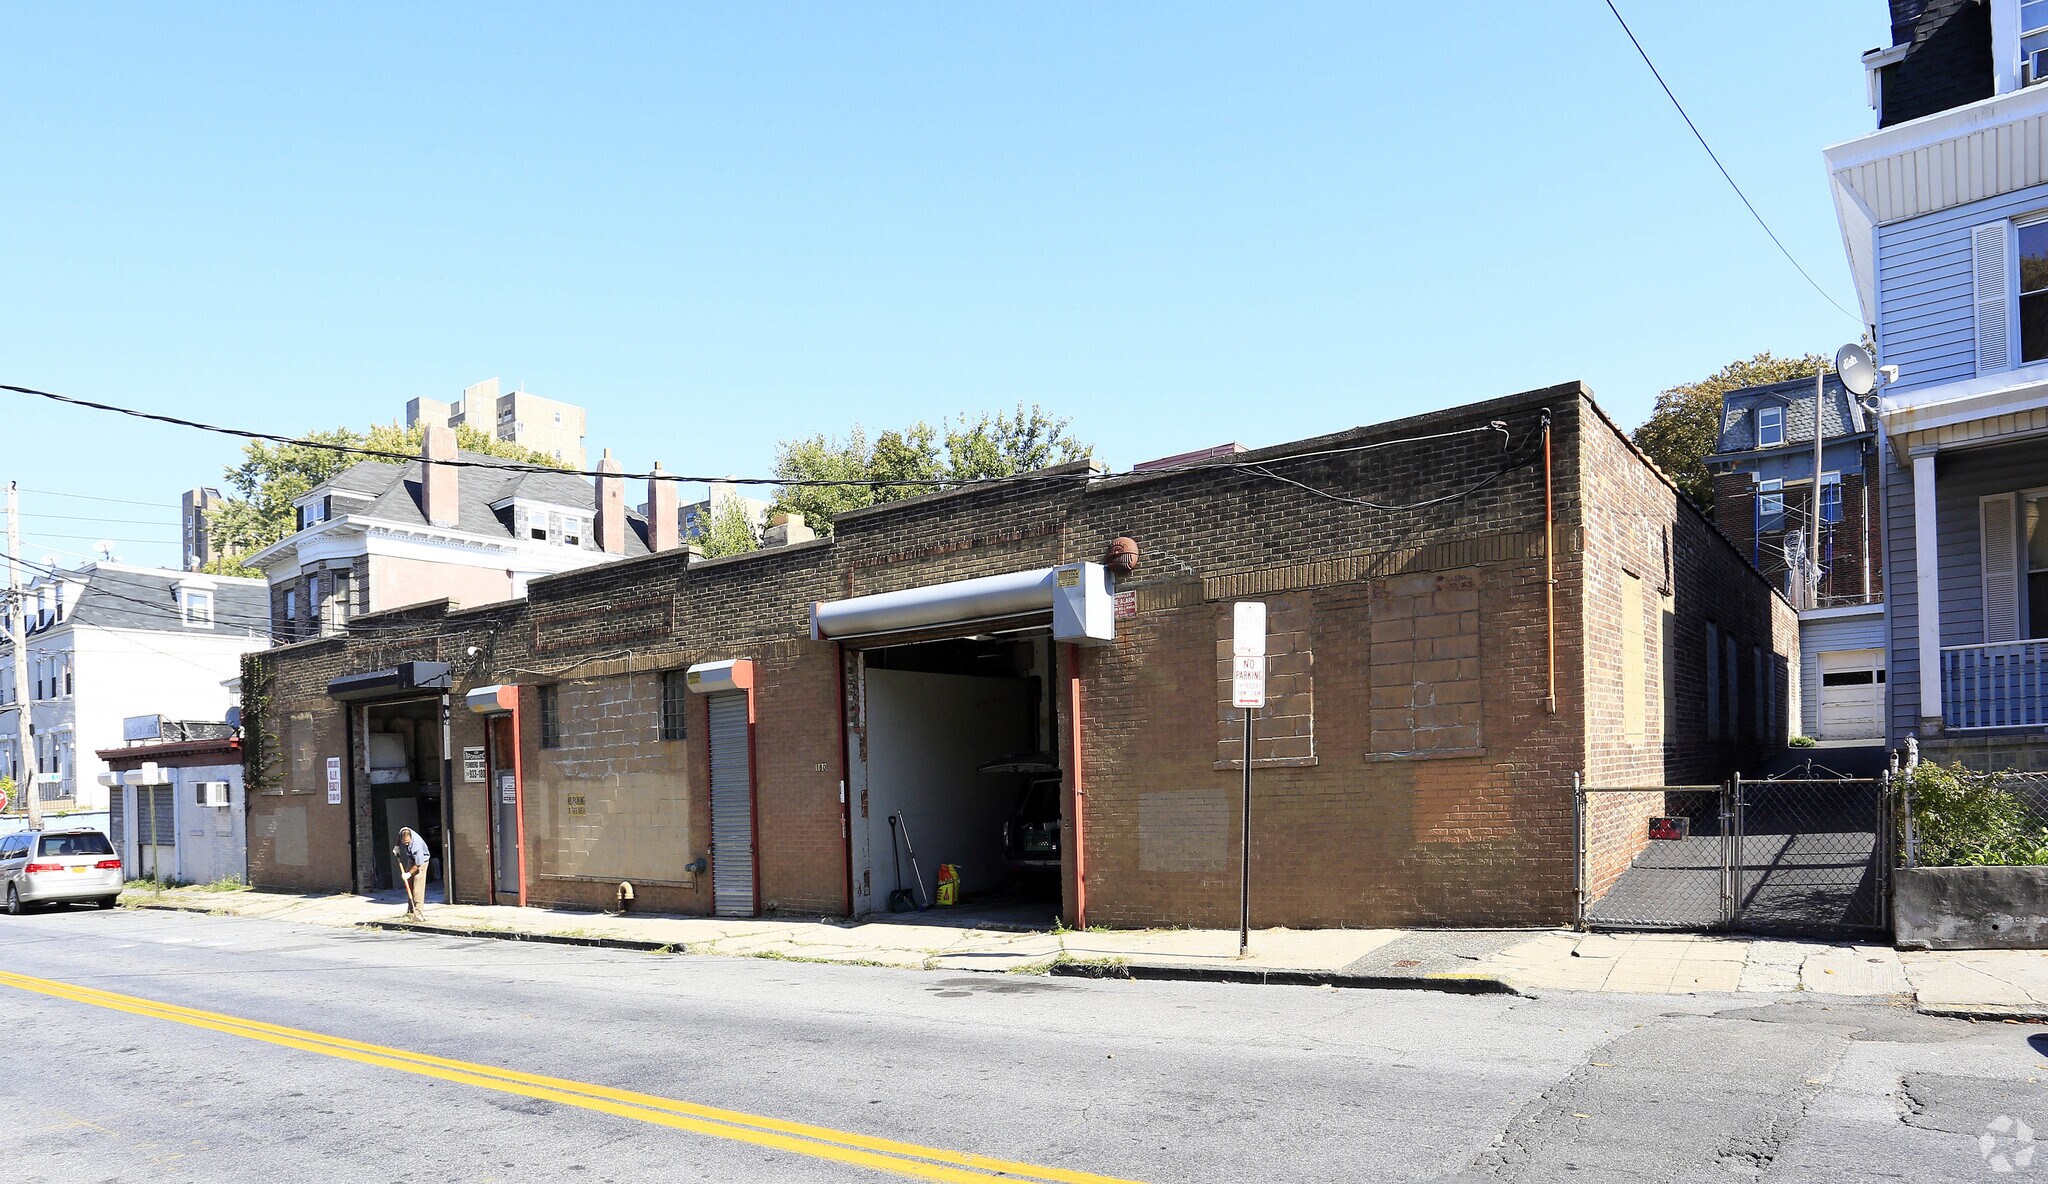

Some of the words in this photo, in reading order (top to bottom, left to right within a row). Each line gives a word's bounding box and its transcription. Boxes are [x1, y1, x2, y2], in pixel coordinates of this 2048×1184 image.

[1842, 354, 1859, 371] dish
[1243, 659, 1255, 670] NO
[1236, 670, 1262, 681] PARKING
